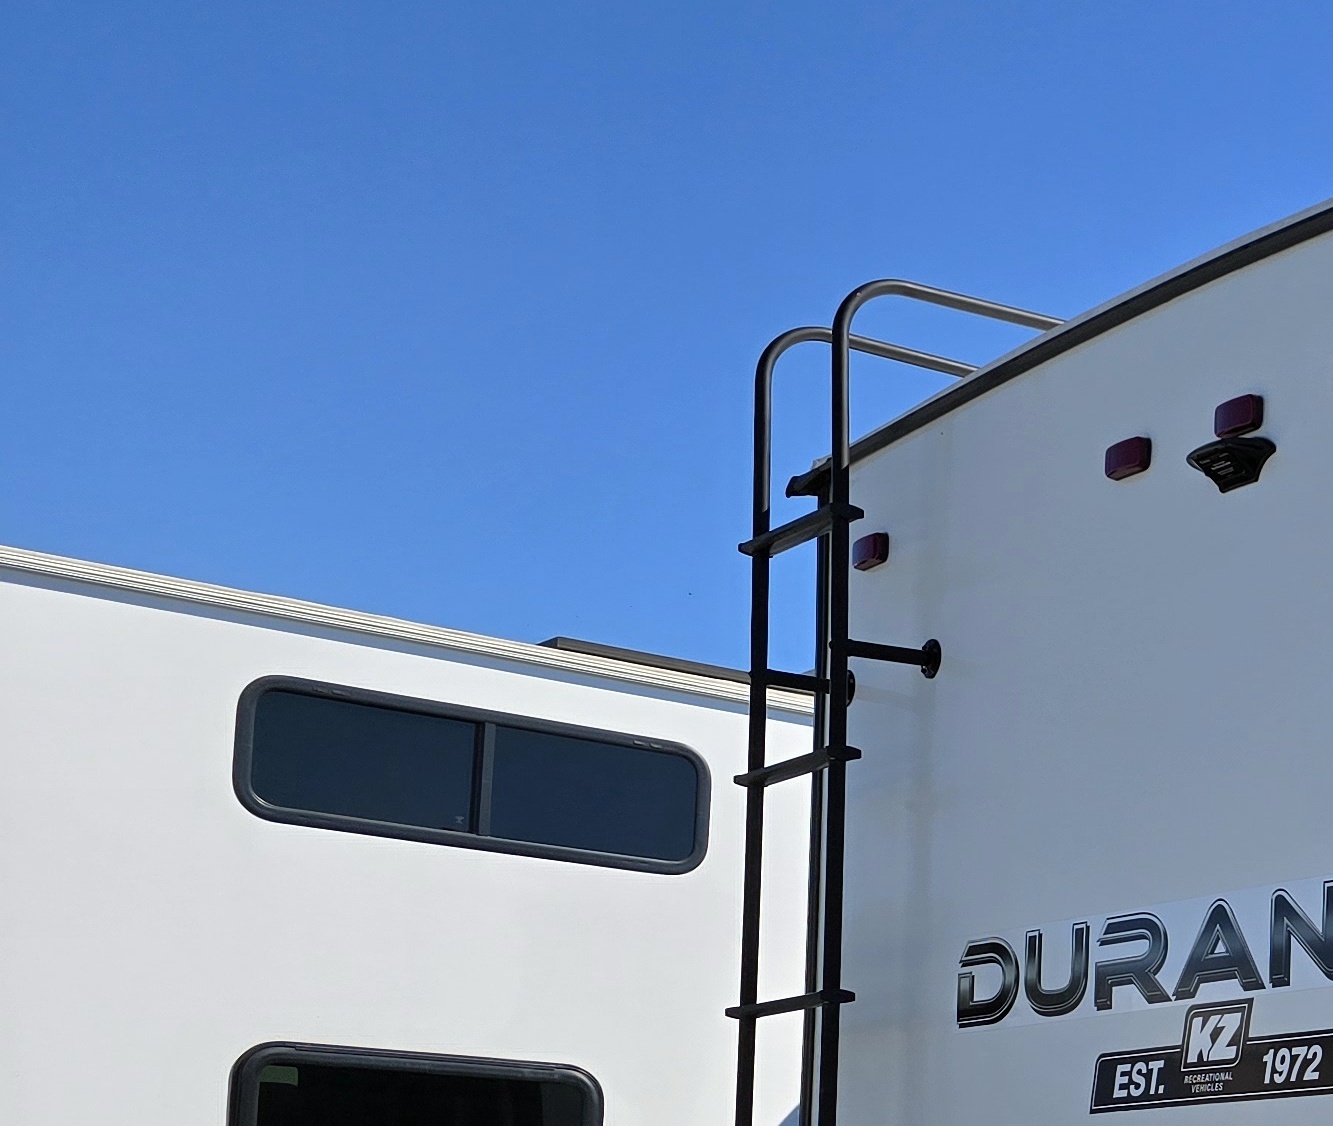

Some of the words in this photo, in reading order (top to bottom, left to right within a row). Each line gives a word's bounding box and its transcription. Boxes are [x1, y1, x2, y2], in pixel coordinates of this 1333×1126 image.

[1187, 1012, 1242, 1064] KZ
[1113, 1060, 1165, 1098] EST.
[1263, 1045, 1323, 1084] 1972
[1184, 1072, 1233, 1084] RECREATIONAL
[1191, 1083, 1224, 1093] VEHICLES
